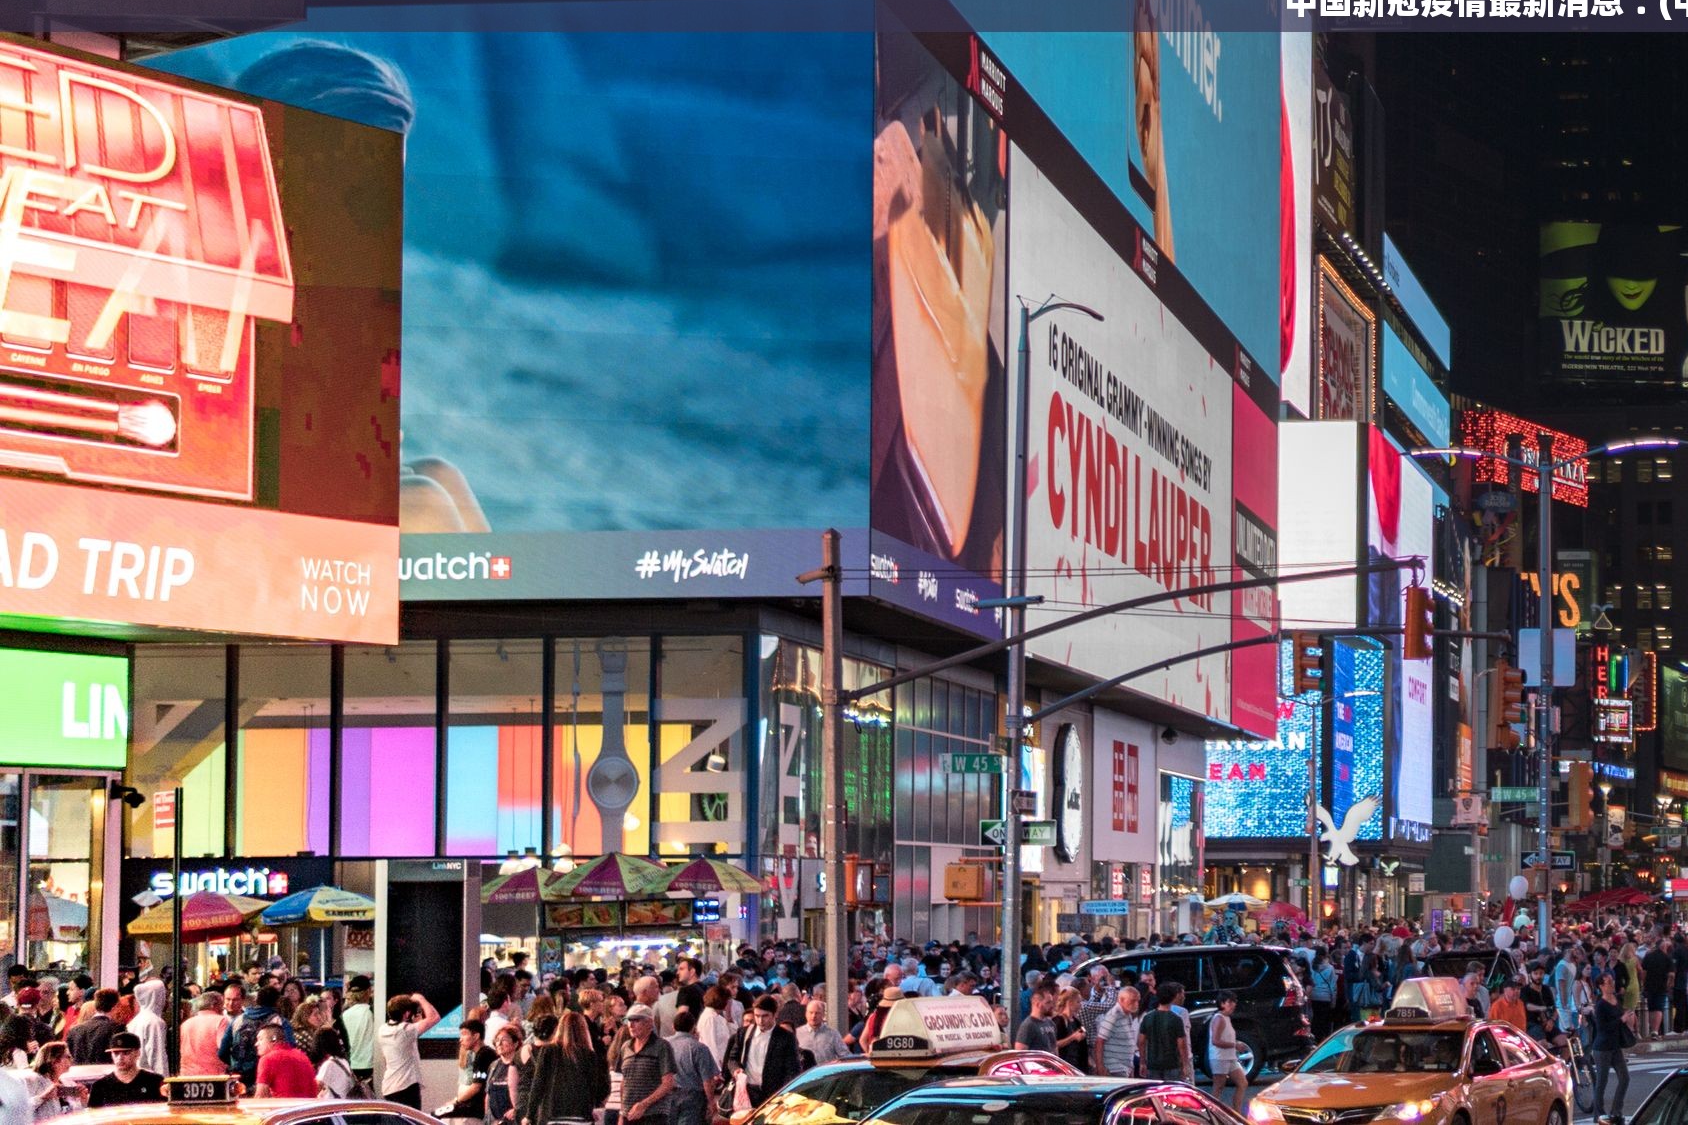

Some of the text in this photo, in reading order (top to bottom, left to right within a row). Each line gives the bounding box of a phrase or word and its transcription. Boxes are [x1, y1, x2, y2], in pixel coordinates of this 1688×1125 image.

[1048, 320, 1059, 372] 16
[1062, 332, 1105, 409] ORIGINAL
[1181, 434, 1203, 485] SONGS
[1203, 455, 1213, 494] BY
[1047, 390, 1216, 613] CYNDI LAUPER
[78, 537, 195, 603] TRIP
[302, 557, 372, 586] WATCH
[301, 586, 370, 617] NOW
[955, 759, 988, 772] W 45
[1514, 790, 1526, 799] 45
[1023, 825, 1045, 839] WAY
[432, 861, 462, 870] LinkNYC
[980, 1012, 995, 1027] DAY
[887, 1037, 914, 1049] 9G80
[183, 1082, 215, 1098] 3D79
